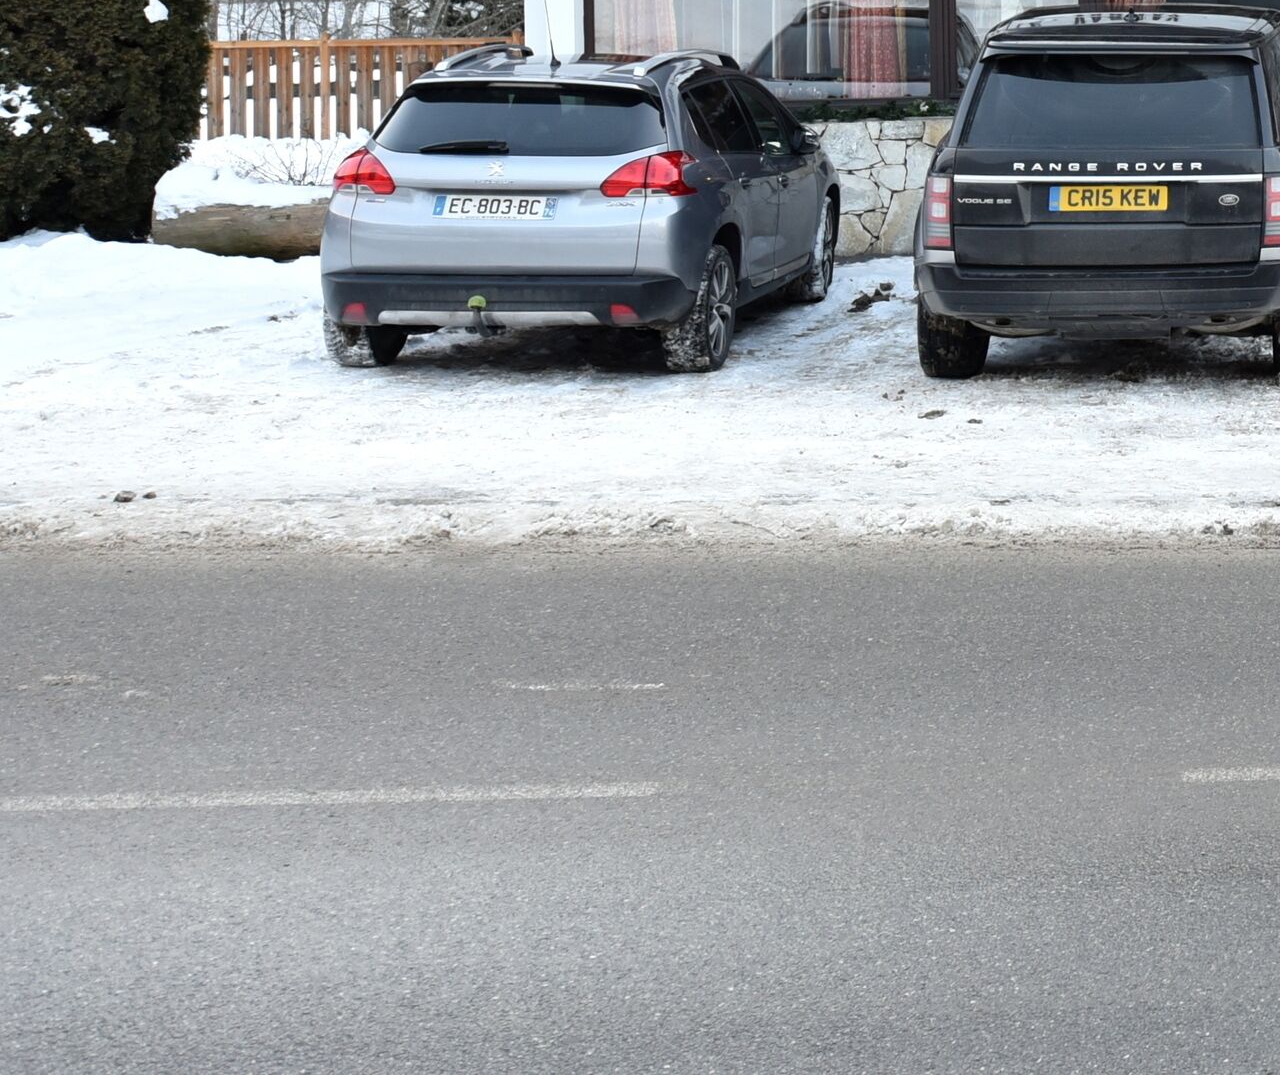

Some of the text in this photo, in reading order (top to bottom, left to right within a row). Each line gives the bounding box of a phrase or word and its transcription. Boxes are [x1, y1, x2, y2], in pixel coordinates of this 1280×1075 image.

[1013, 162, 1203, 172] RANGE ROVER
[957, 197, 1013, 205] VOGUE SE
[1067, 187, 1161, 208] CR15 KEW
